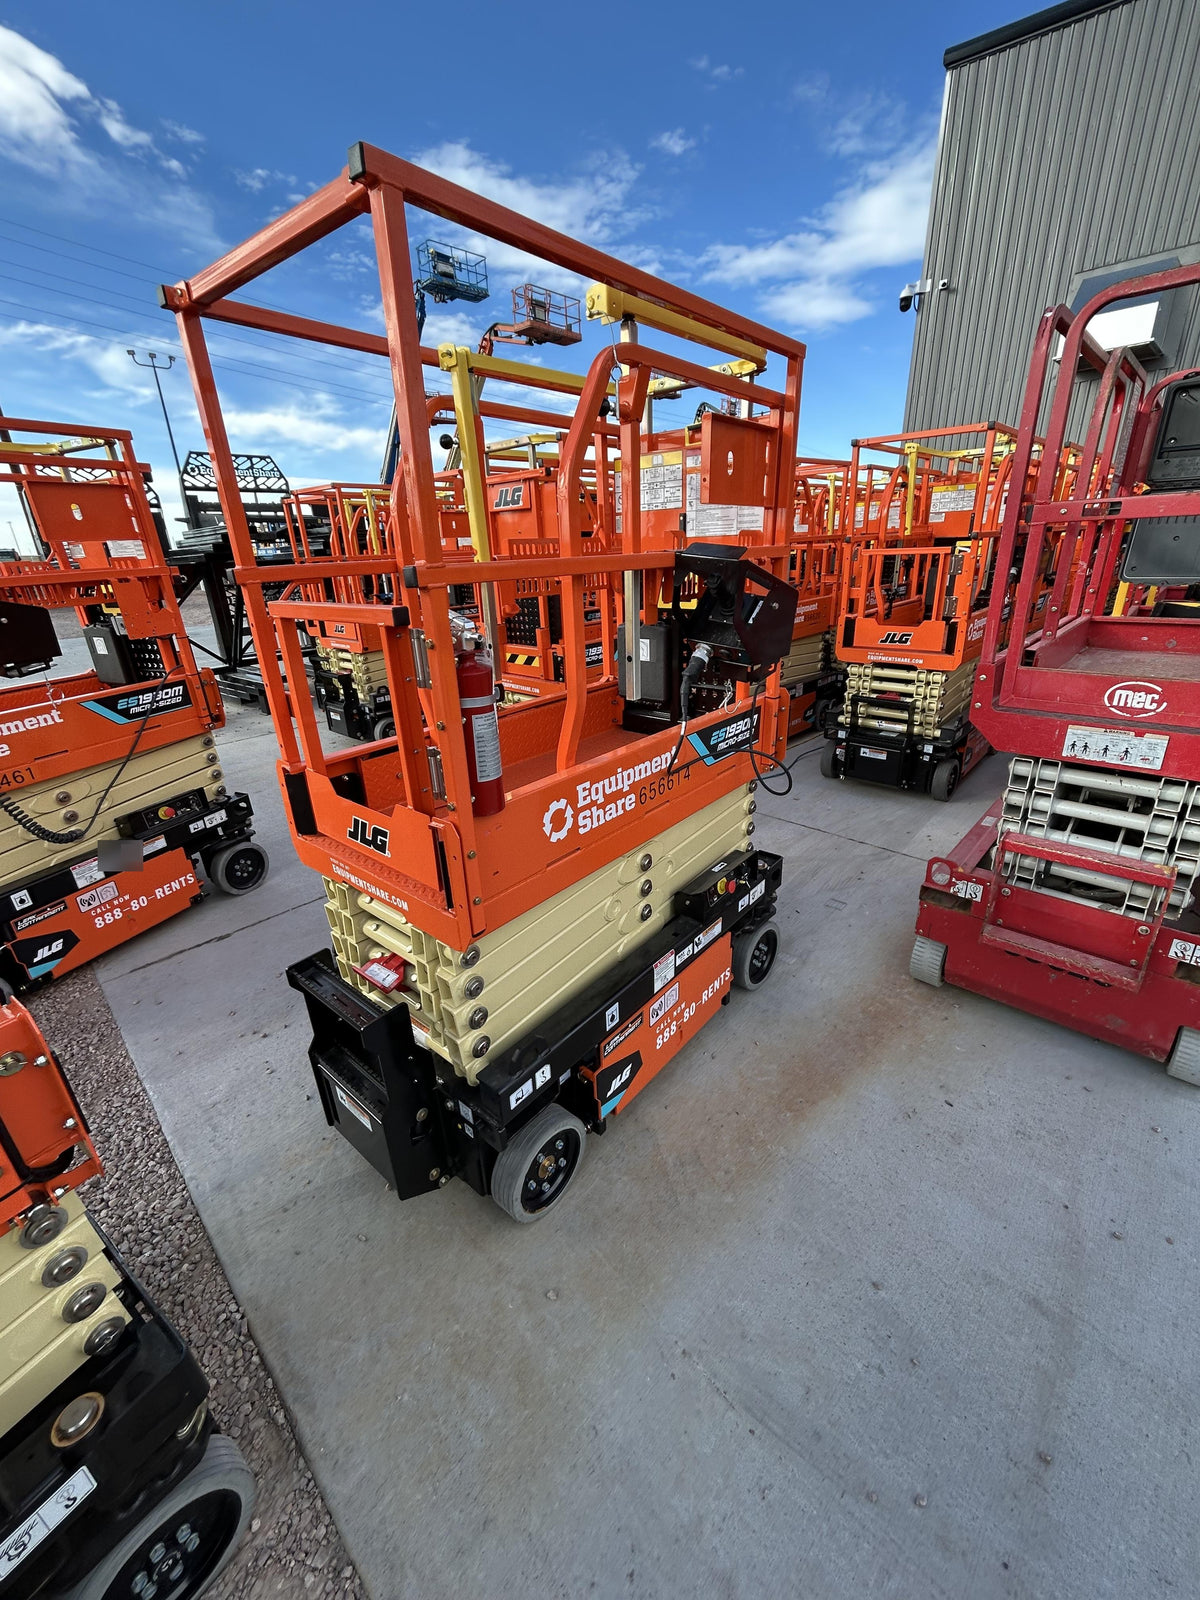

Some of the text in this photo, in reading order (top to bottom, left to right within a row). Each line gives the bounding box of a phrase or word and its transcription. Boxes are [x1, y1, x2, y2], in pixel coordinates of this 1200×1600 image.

[200, 466, 280, 478] EqentShare
[494, 485, 524, 509] JLG
[796, 602, 818, 615] uipment
[334, 624, 346, 635] JLG
[879, 632, 914, 646] JLG
[867, 655, 924, 664] EQUIPMENTSHARE.COM
[117, 685, 184, 710] ES1930M
[0, 709, 64, 737] ment
[0, 767, 36, 790] 461
[576, 745, 678, 809] Equipment
[577, 793, 636, 835] Share
[346, 815, 391, 857] JLG
[331, 863, 409, 912] EQUIPMENTSHARE.COM
[90, 894, 131, 917] CALL NOW
[95, 873, 195, 929] 888-80-RENTS
[33, 938, 64, 963] JLG
[655, 967, 731, 1051] 888-80-RENTS
[656, 1002, 687, 1034] CALL NOW
[606, 1062, 633, 1099] JLG
